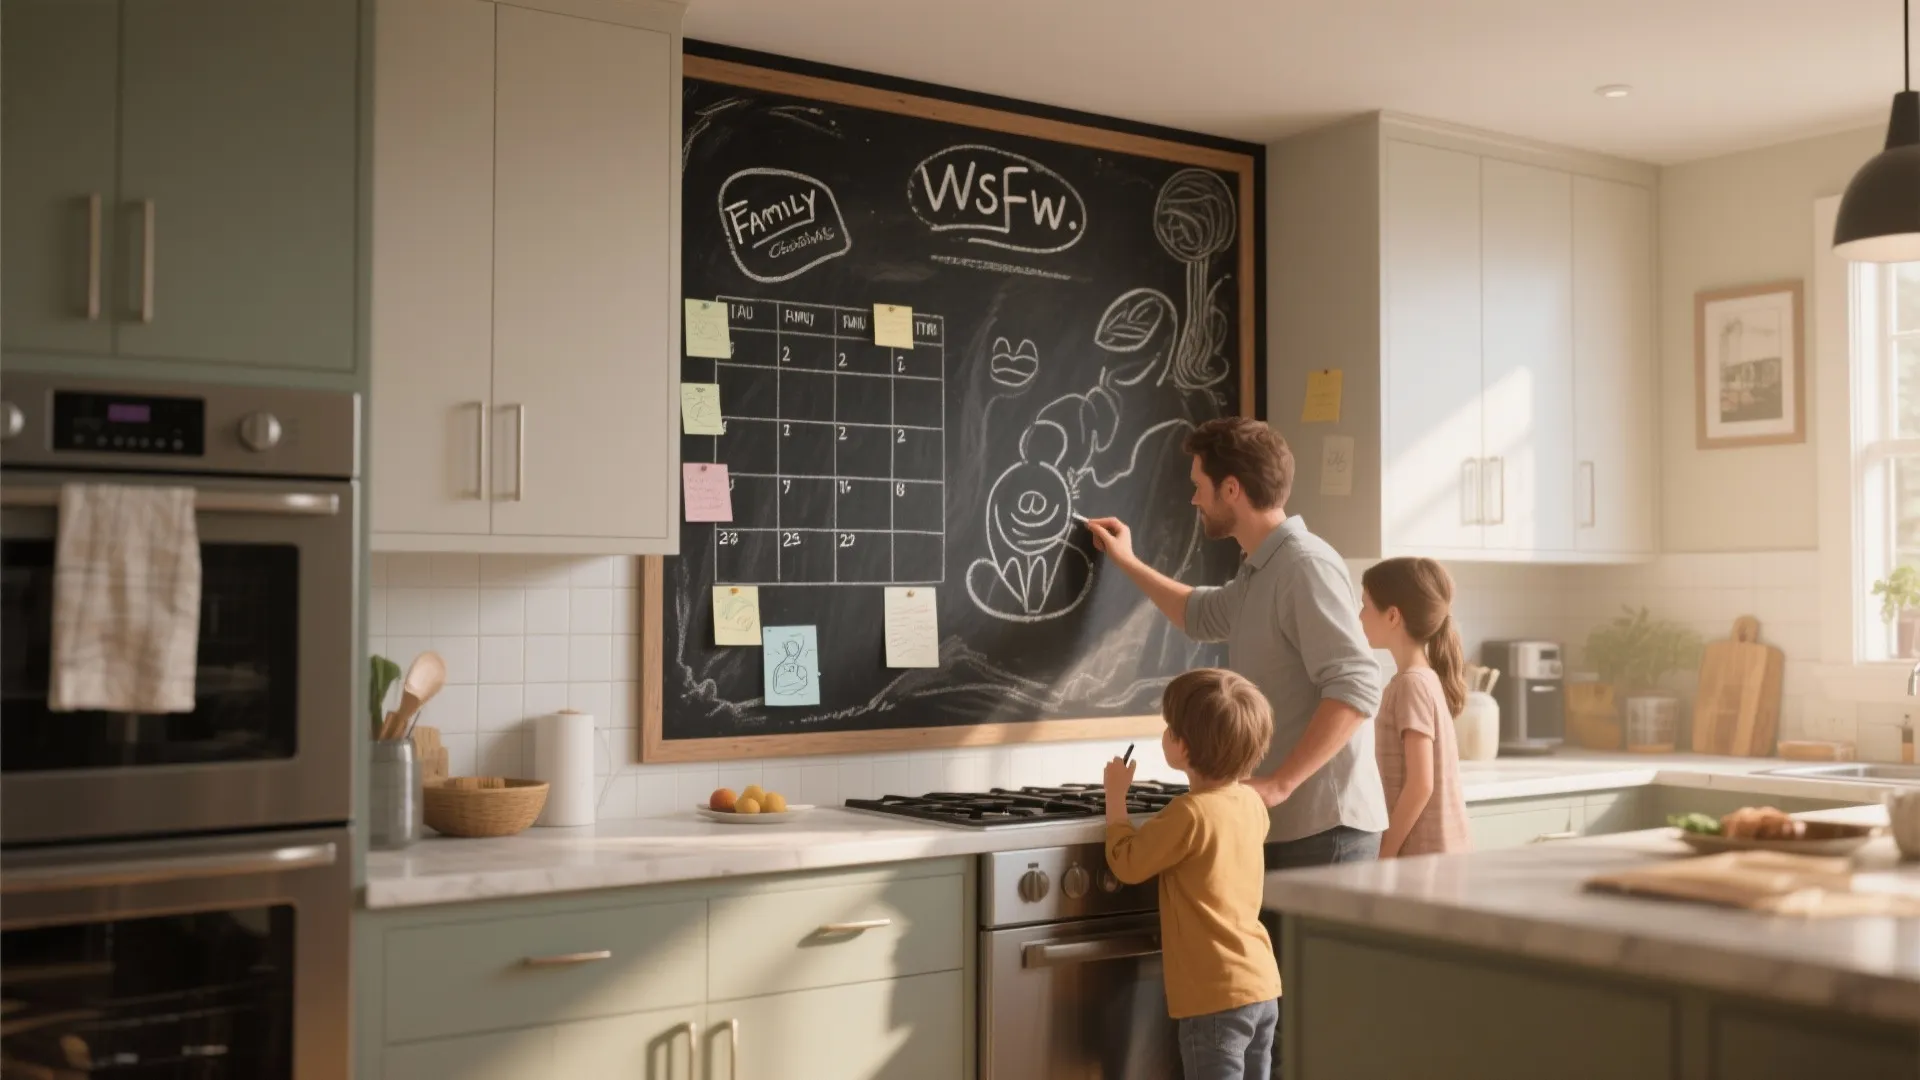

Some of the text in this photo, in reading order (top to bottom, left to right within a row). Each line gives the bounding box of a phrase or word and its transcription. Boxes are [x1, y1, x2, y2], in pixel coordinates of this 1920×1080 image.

[724, 188, 816, 245] FAMILY
[782, 346, 791, 362] 2
[838, 352, 848, 367] 2
[897, 429, 906, 443] 2
